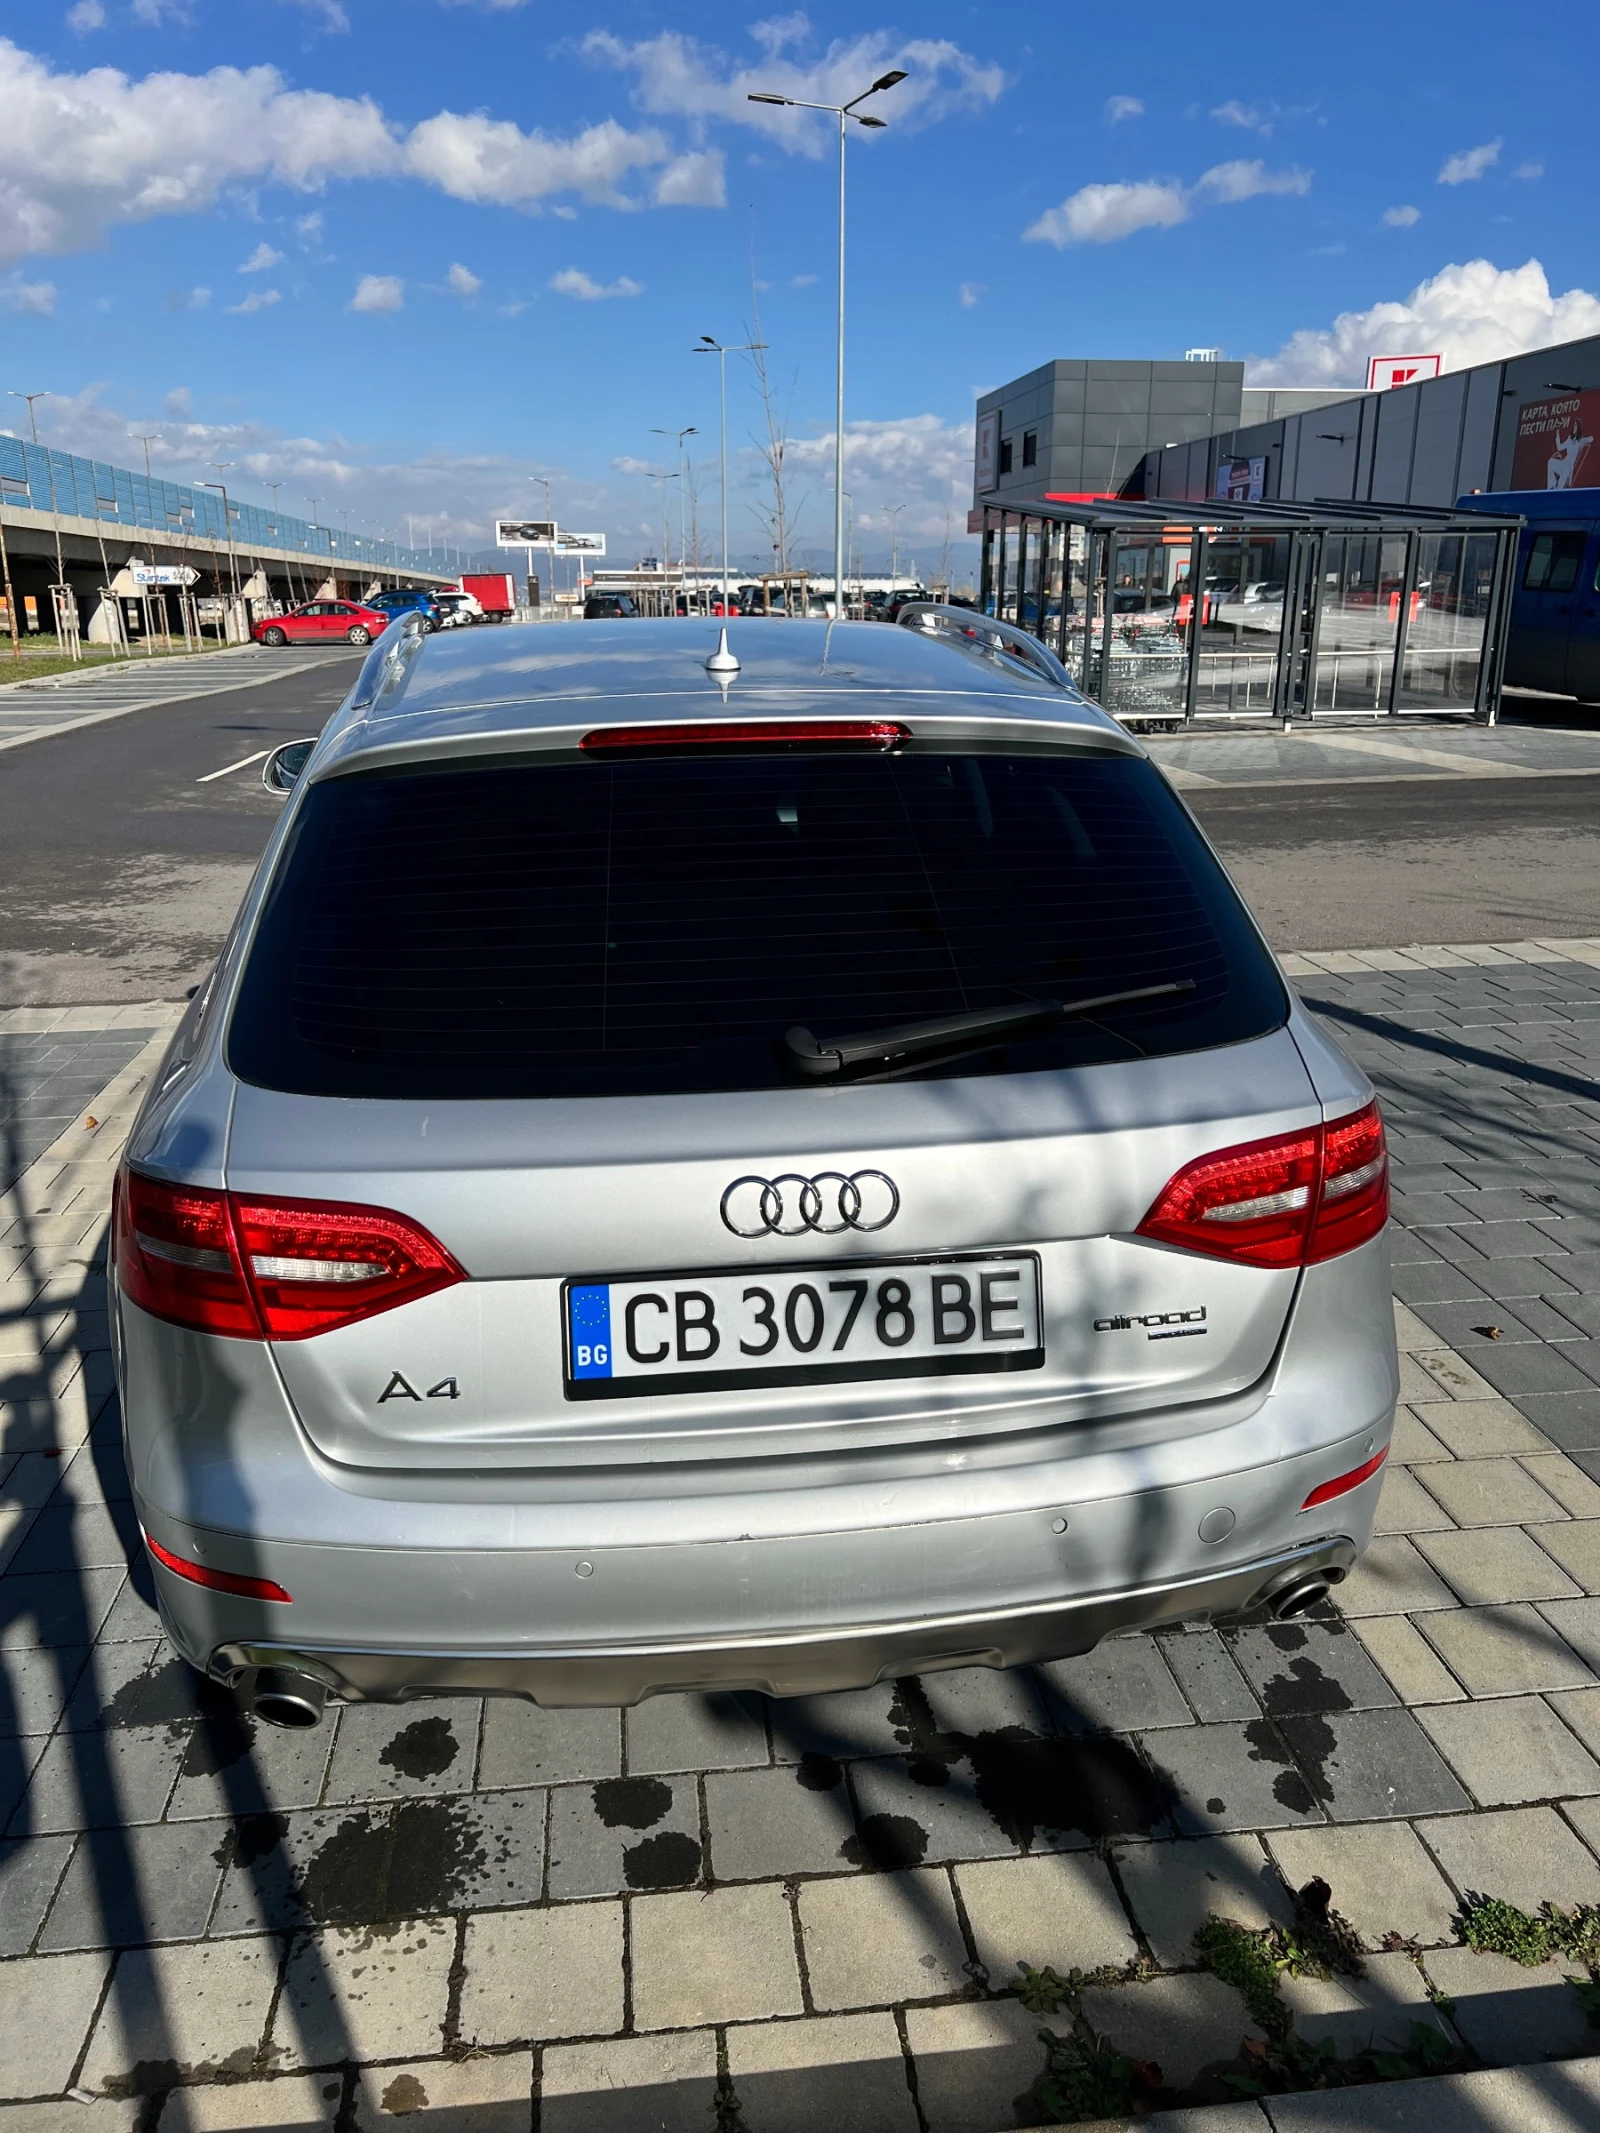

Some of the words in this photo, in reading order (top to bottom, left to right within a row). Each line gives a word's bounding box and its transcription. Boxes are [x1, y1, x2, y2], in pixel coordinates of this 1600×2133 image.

[1521, 405, 1549, 421] КАРТА,
[1550, 399, 1581, 416] КОЯТО
[1519, 421, 1546, 436] ПЕСТИ
[624, 1290, 721, 1365] CB
[739, 1278, 916, 1357] 3078
[931, 1270, 1026, 1346] BE
[1093, 1303, 1207, 1332] allroad
[577, 1344, 608, 1367] BG
[376, 1369, 462, 1404] A4
